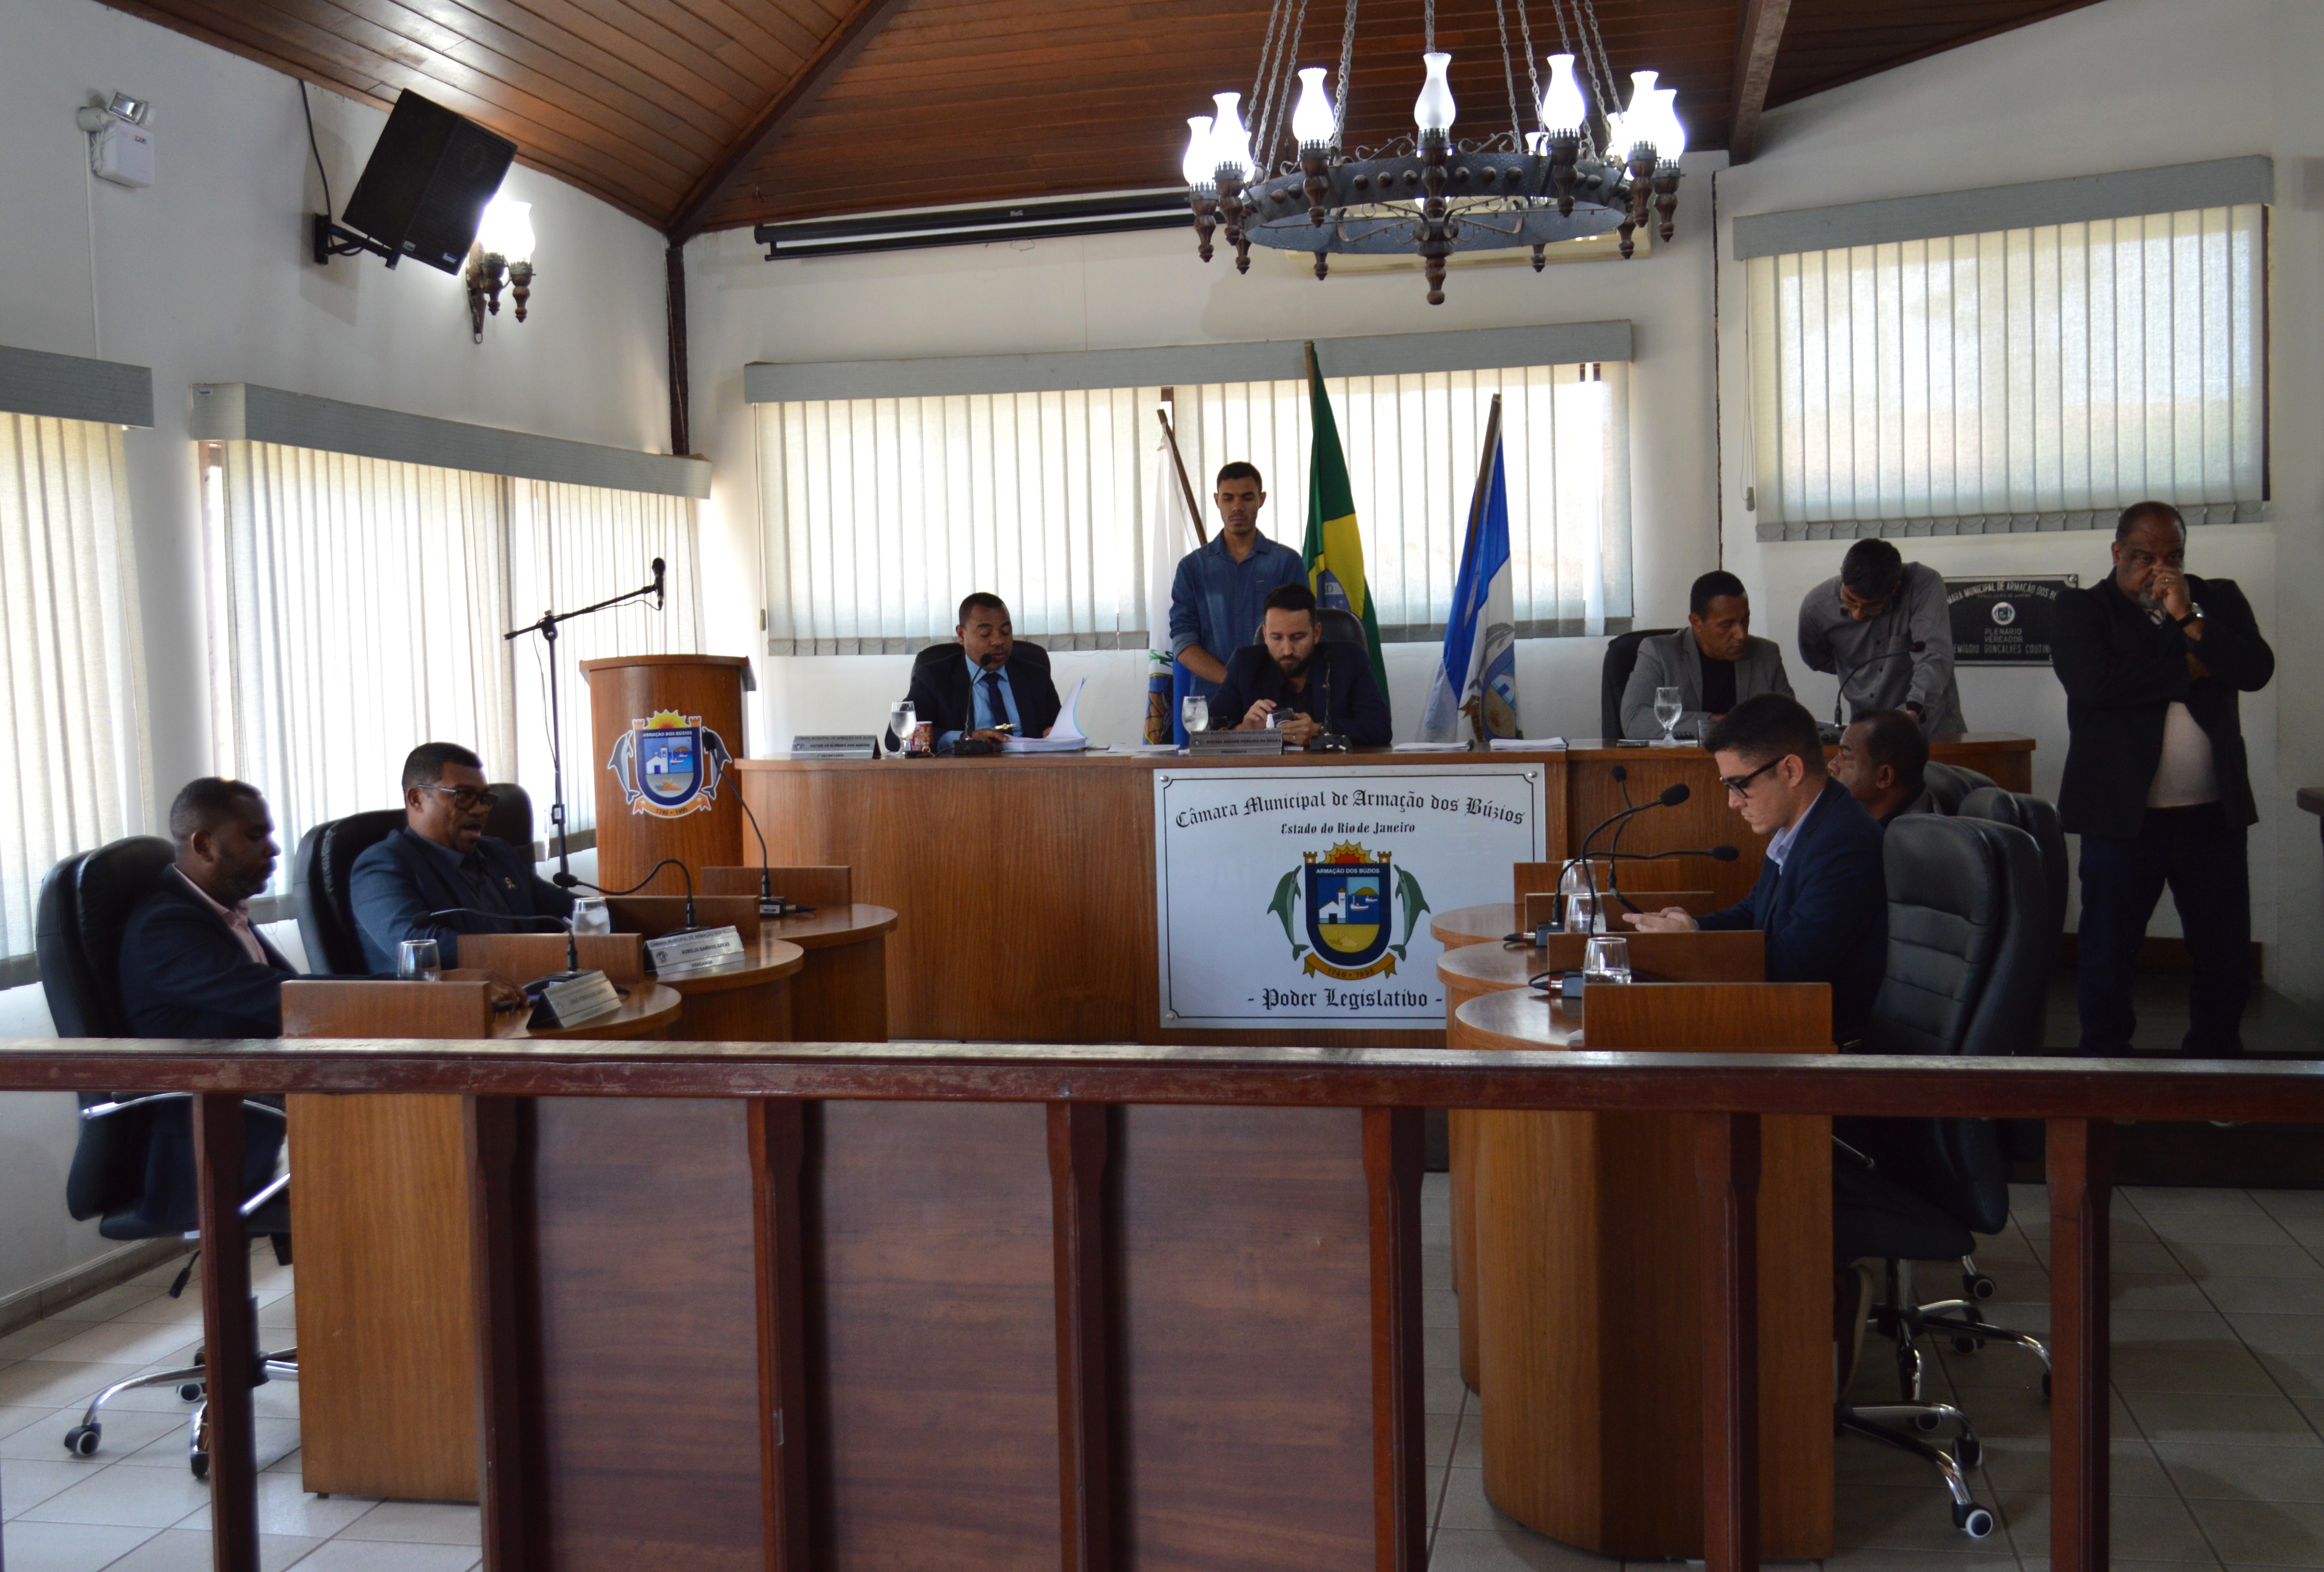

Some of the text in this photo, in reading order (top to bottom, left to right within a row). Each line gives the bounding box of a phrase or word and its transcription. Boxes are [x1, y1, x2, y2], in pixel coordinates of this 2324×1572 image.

[1947, 591, 1963, 604] MARA
[1963, 583, 1996, 596] MUNICIPAL
[1997, 582, 2004, 591] DE
[2006, 582, 2036, 593] ARMAÇÃO
[2036, 586, 2049, 597] DOS
[1984, 643, 2022, 654] GONÇALVES
[676, 806, 688, 814] 1995
[1175, 789, 1525, 828] Câmara Municipal de Armação dos Búzios
[1281, 822, 1415, 834] Estado do Rio de Janeiro
[1328, 968, 1375, 978] 1740 1995
[1262, 988, 1317, 1011] Poder
[1324, 988, 1428, 1011] Legislativo
